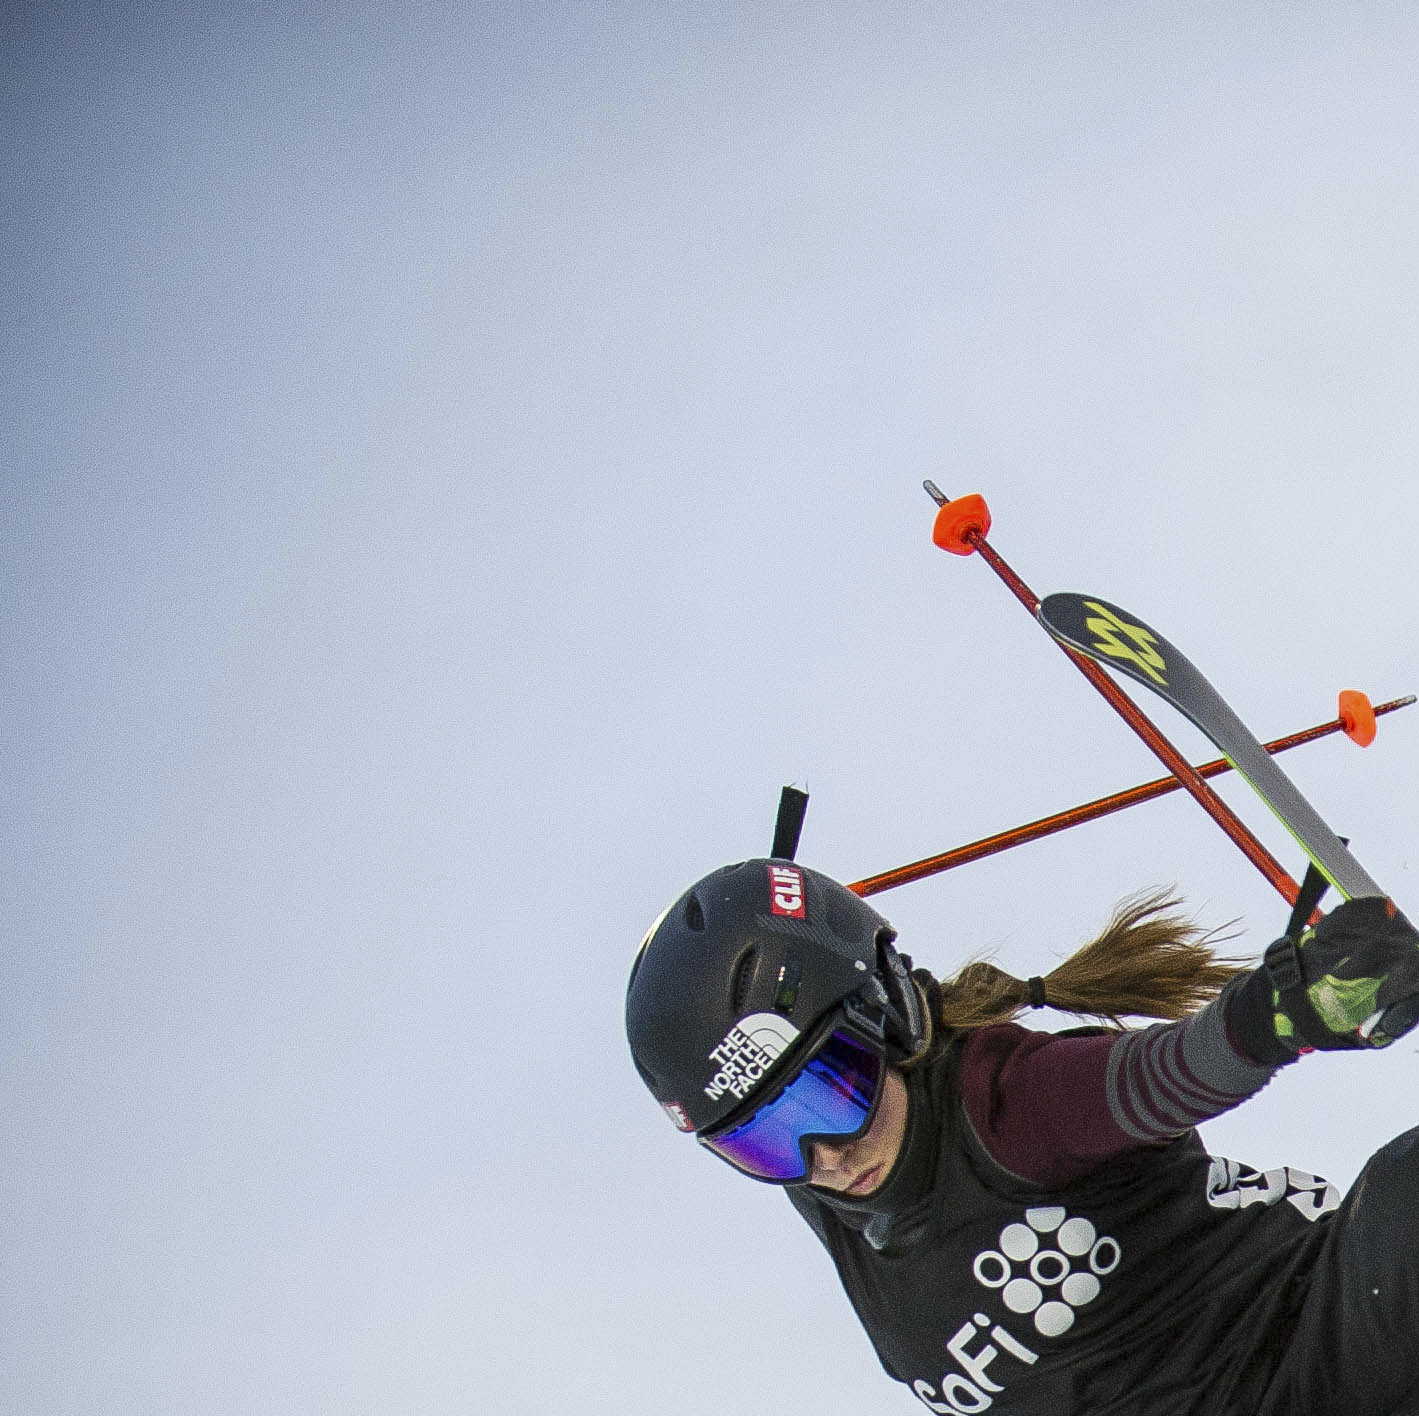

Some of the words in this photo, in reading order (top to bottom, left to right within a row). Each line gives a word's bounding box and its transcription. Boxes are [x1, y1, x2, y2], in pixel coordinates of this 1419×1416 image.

[704, 1039, 762, 1101] NORTH
[708, 1027, 748, 1065] THE
[729, 1051, 775, 1100] FACE
